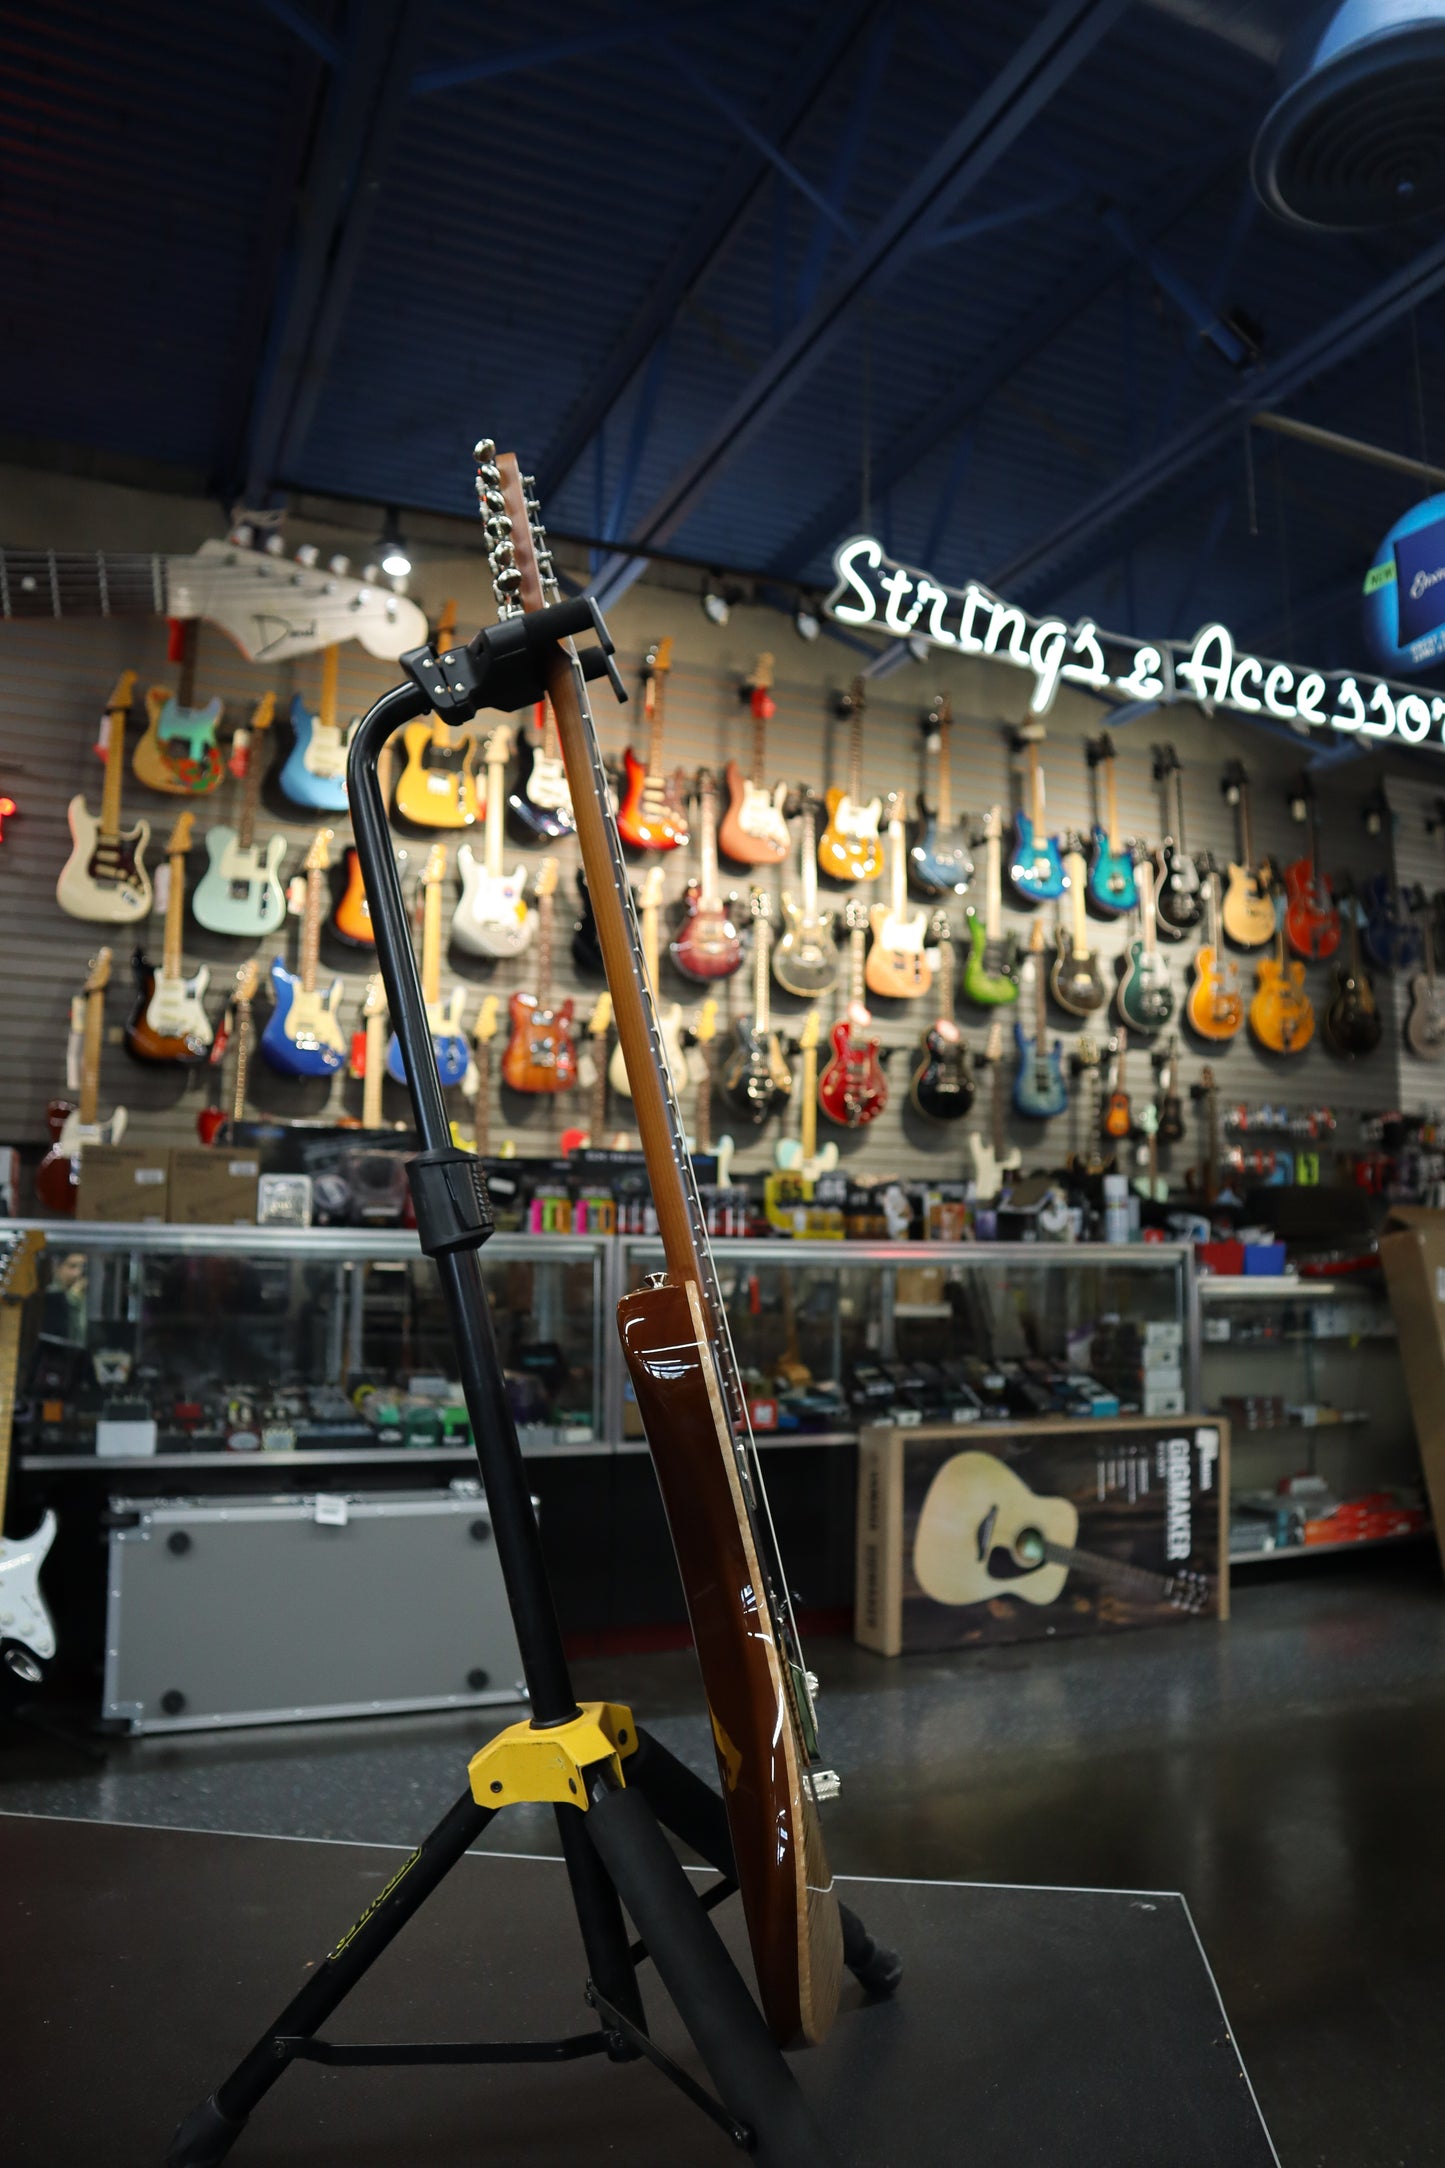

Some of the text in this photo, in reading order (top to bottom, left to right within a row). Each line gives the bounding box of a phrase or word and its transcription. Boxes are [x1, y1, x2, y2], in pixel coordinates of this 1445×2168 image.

[834, 538, 1110, 712] Strings
[1116, 646, 1164, 699] &
[1167, 1438, 1190, 1560] GIGMAKER
